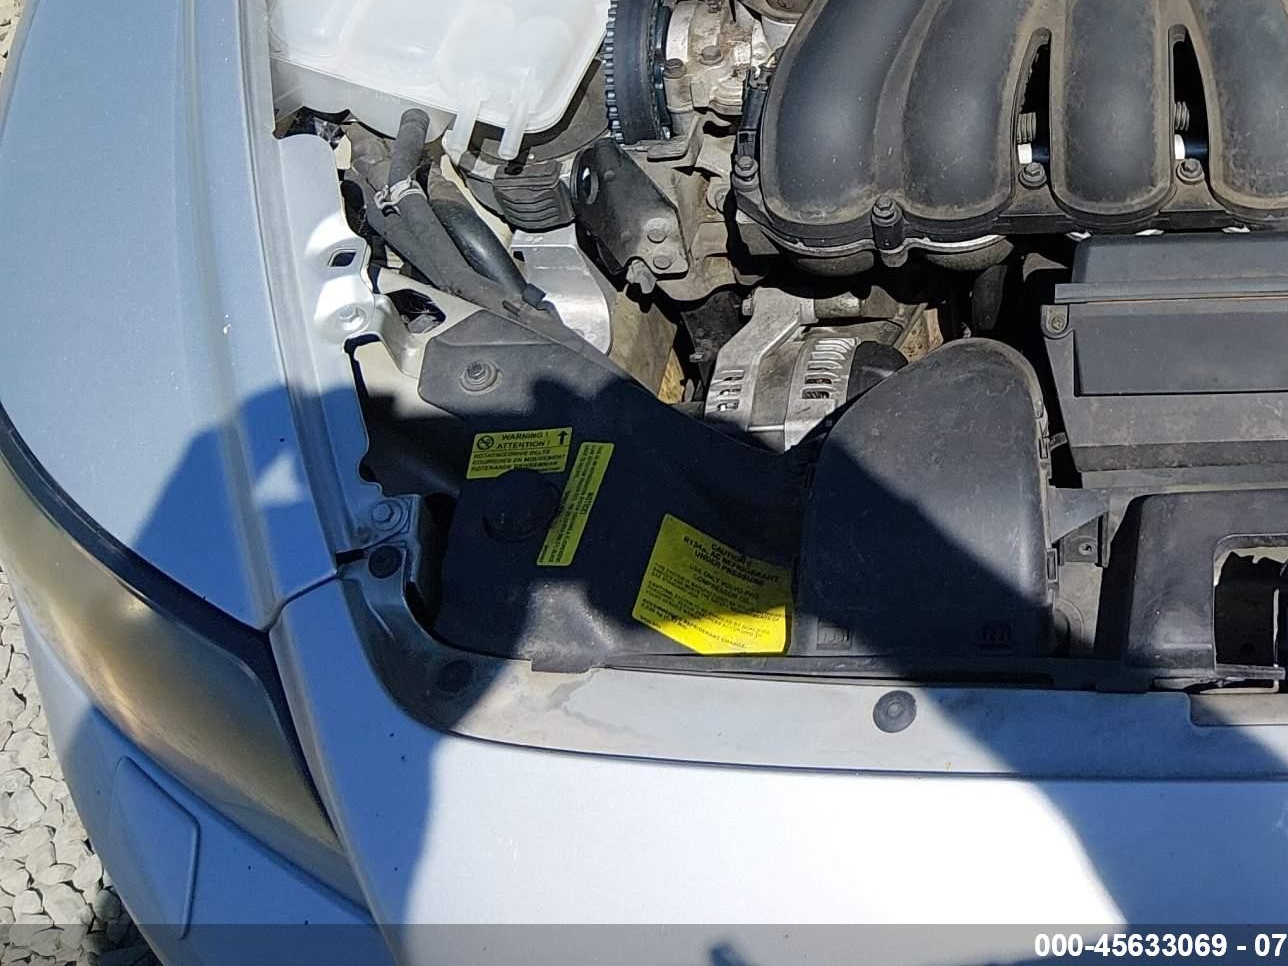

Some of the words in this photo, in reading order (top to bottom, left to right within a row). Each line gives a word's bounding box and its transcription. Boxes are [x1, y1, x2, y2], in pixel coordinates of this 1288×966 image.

[496, 440, 545, 449] ATTENTION
[695, 551, 721, 568] UNDER
[723, 564, 764, 586] PRESSURE
